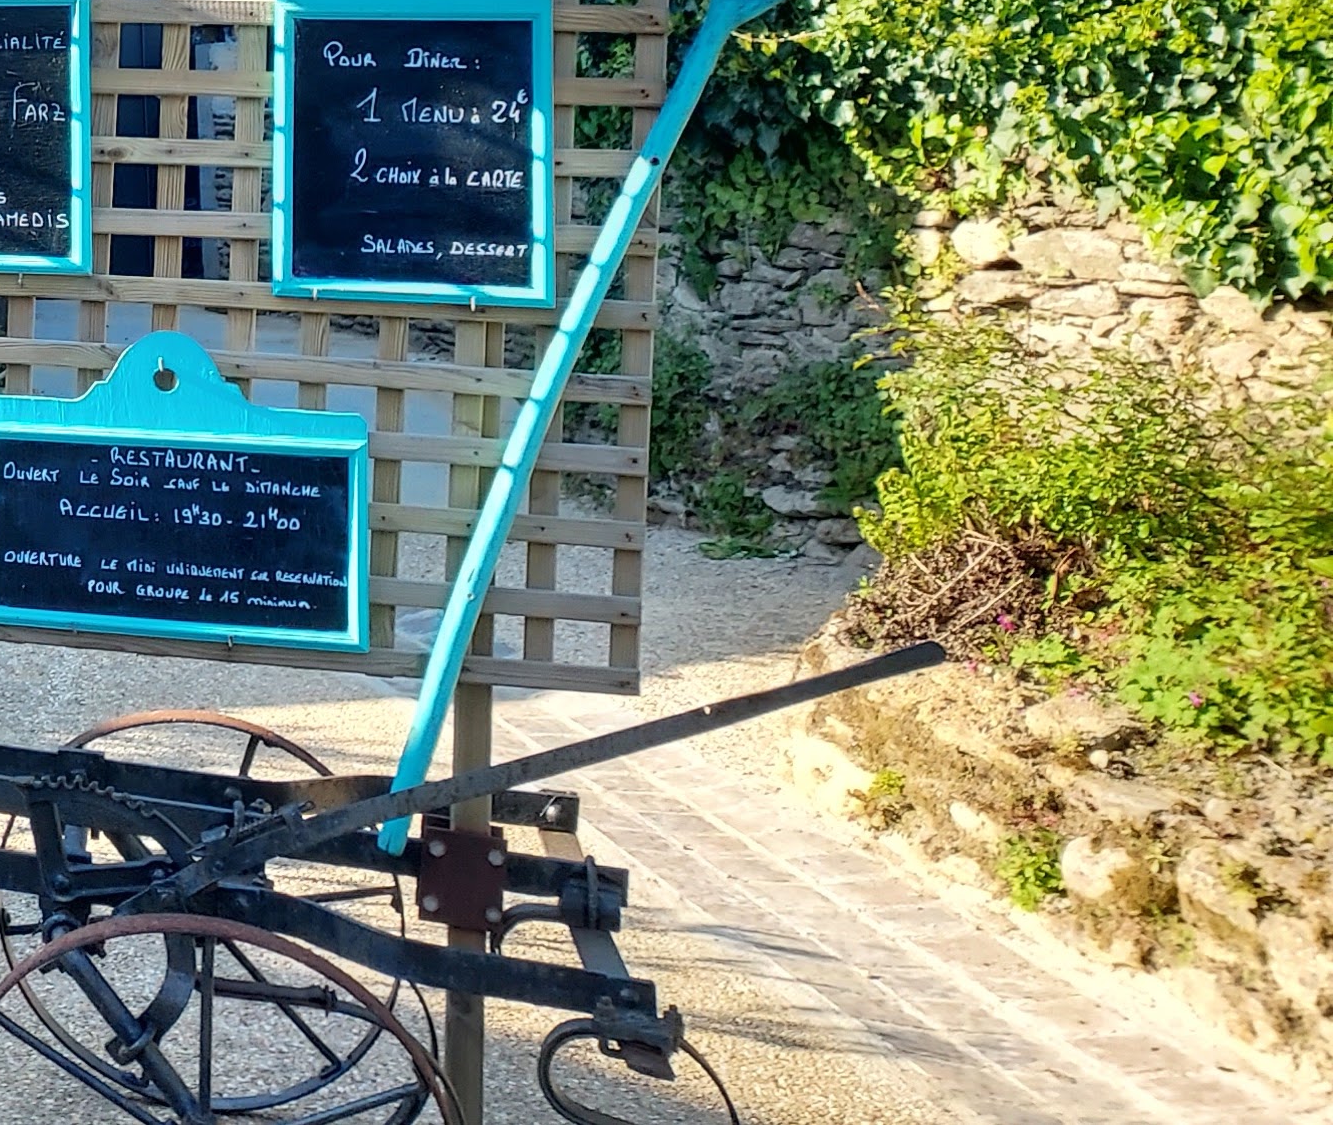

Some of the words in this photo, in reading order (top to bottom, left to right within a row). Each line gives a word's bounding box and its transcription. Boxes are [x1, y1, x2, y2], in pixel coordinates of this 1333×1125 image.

[323, 41, 377, 67] POUR
[13, 82, 66, 122] FARZ
[356, 87, 382, 123] 1
[402, 97, 465, 124] MENU
[350, 147, 369, 183] 2
[376, 167, 422, 185] CHOIX
[466, 169, 524, 188] CARTE
[110, 447, 249, 473] RESTAURANT
[3, 461, 60, 482] OUVERT
[80, 470, 100, 485] LE
[110, 468, 150, 488] SOIR
[163, 478, 200, 491] SAUF
[245, 480, 322, 498] DIMANCHE
[4, 550, 82, 568] OUVERTURE
[100, 558, 119, 571] LE
[166, 561, 245, 581] UNIQUEMENT
[87, 579, 126, 595] POUR
[136, 584, 190, 600] GROUPE
[219, 590, 240, 604] 15
